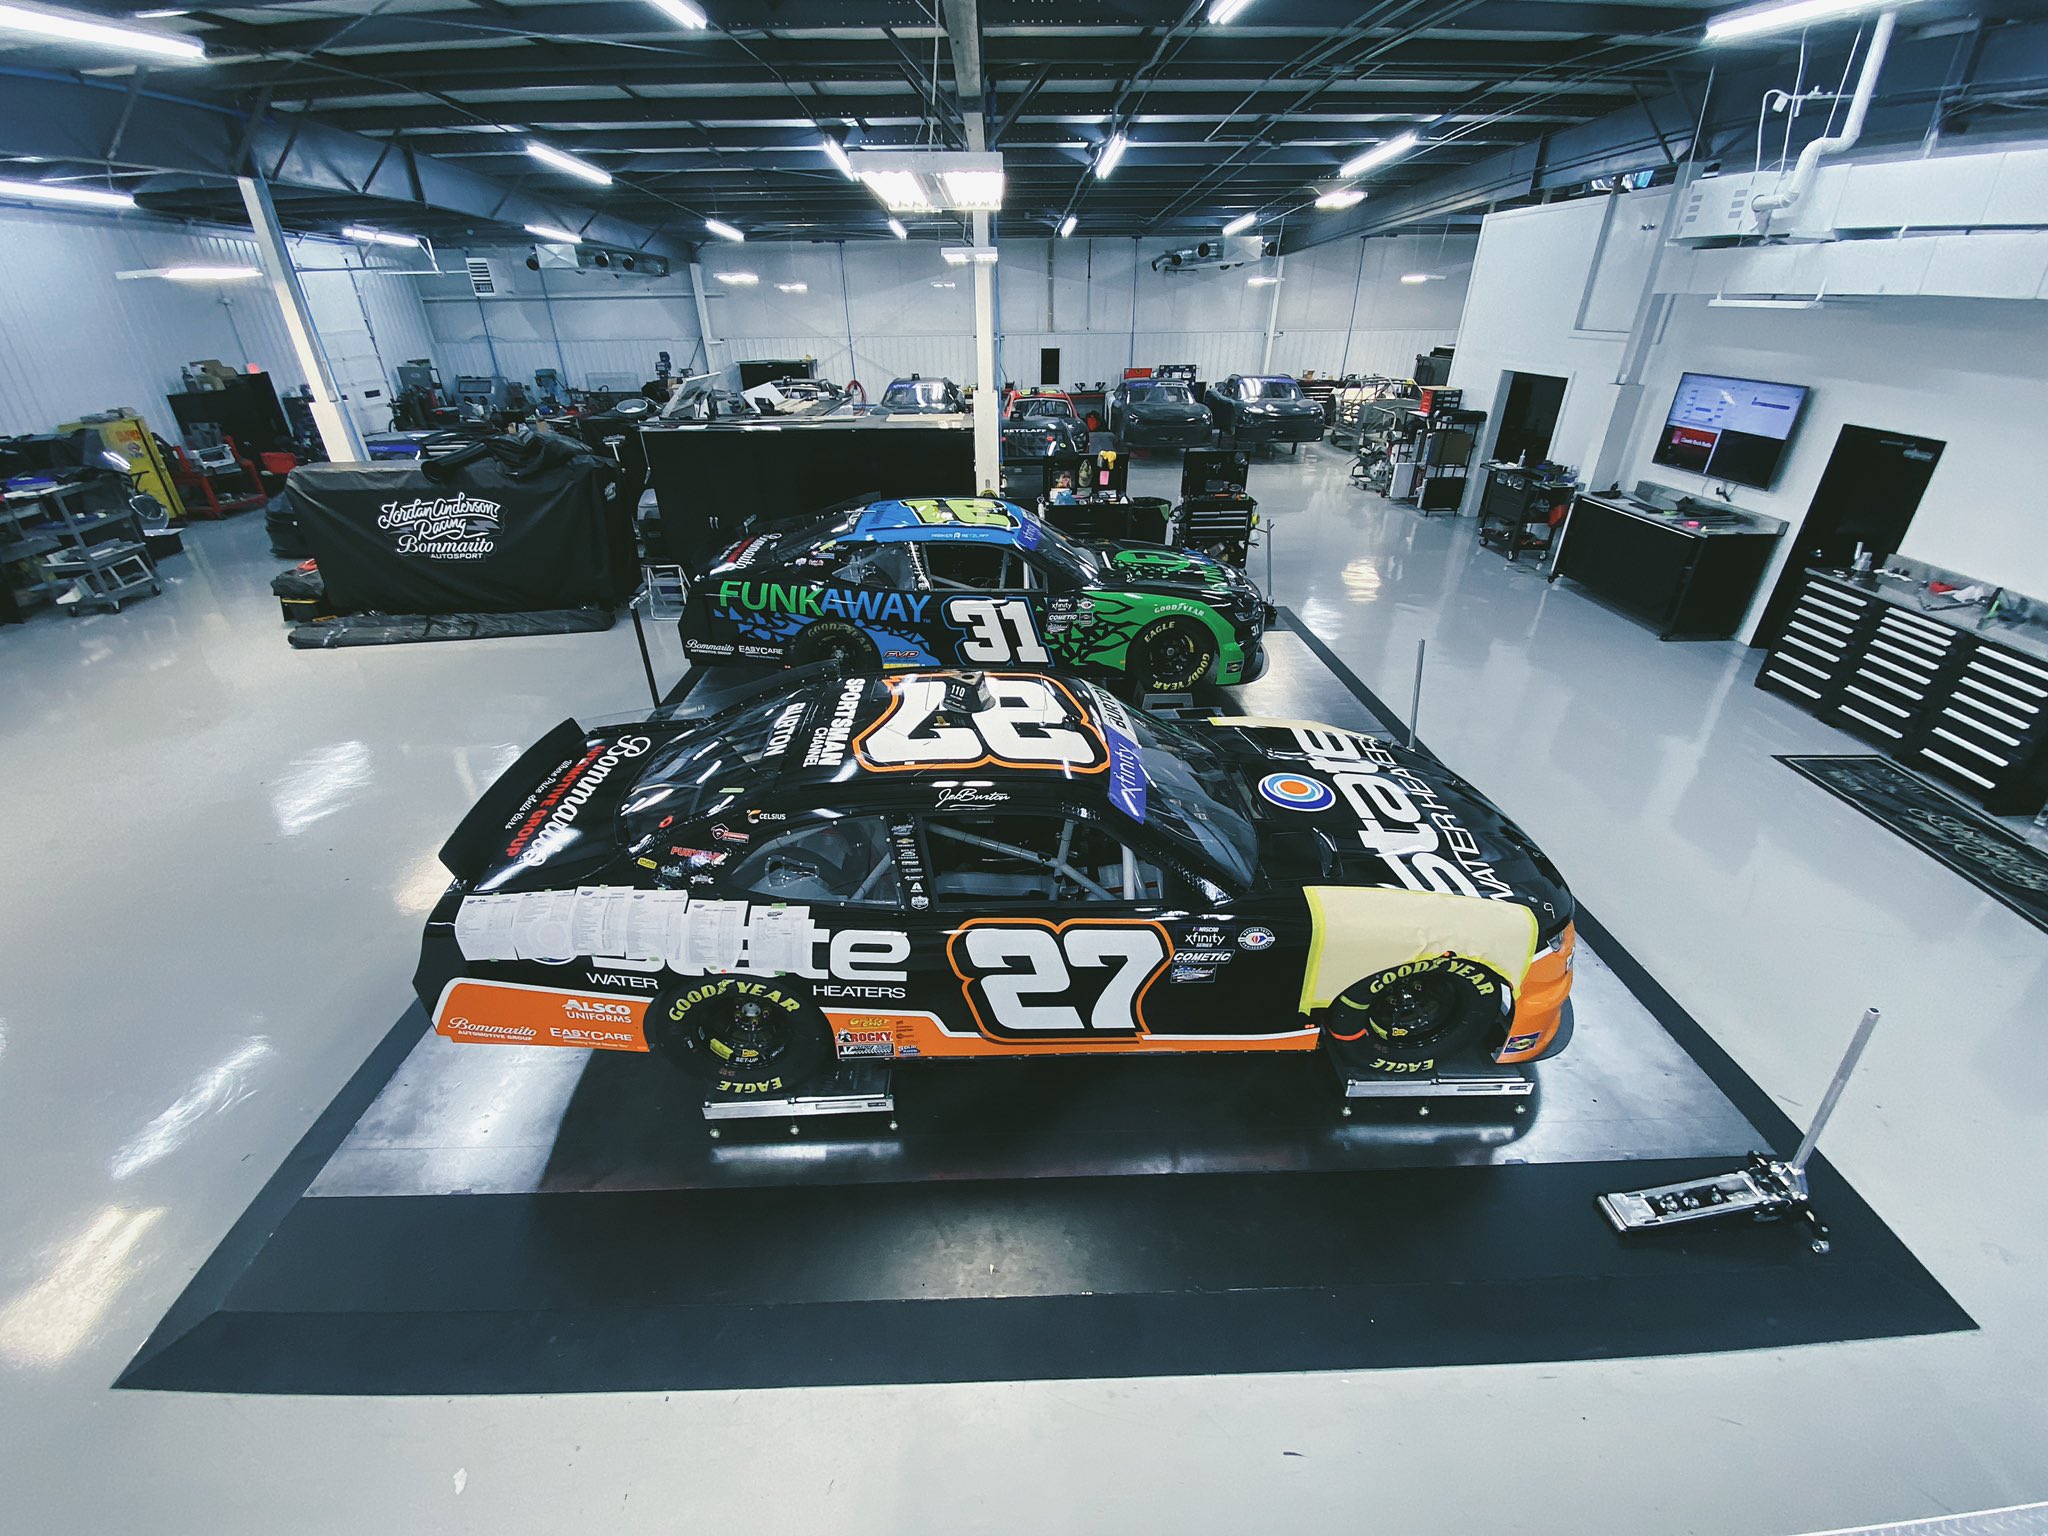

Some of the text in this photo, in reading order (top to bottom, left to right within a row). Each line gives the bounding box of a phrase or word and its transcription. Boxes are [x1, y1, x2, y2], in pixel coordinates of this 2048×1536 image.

[378, 491, 501, 529] Jordan Anderson
[414, 518, 470, 541] Racing
[396, 534, 494, 553] Bommarito
[1154, 602, 1205, 617] GOODYEAR
[950, 600, 1049, 663] 31
[1143, 620, 1176, 643] EAGLE
[1250, 625, 1261, 637] 31
[685, 639, 735, 652] Bommarito
[951, 684, 966, 697] 110
[764, 702, 807, 757] BURTON
[818, 678, 866, 766] SPORTSMAN
[866, 681, 1095, 763] 27
[803, 726, 828, 768] CHANNEL
[1113, 742, 1143, 817] xfinity
[1355, 735, 1449, 811] HEAERS
[535, 777, 557, 794] Price
[505, 745, 606, 858] AUTOMOTIVE GROUP
[520, 793, 538, 813] Sells
[523, 735, 651, 867] Bommarito
[504, 811, 525, 830] Cars
[759, 813, 786, 821] CELSIUS
[1185, 932, 1226, 946] xfinity
[1173, 951, 1232, 962] COMETIC
[586, 972, 659, 990] WATER
[966, 929, 1164, 1029] 27
[1370, 951, 1495, 996] GOODYEAR
[669, 979, 800, 1021] GOODYEAR
[813, 985, 906, 999] HEATERS
[562, 999, 631, 1015] ALSCO
[448, 1017, 537, 1036] Bommarito
[566, 1011, 632, 1024] UNIFORMS
[458, 1030, 505, 1039] AUTOMOTIVE
[851, 1031, 892, 1043] ROCKY
[1370, 1058, 1434, 1073] EAGLE
[716, 1076, 783, 1094] EAGLE
